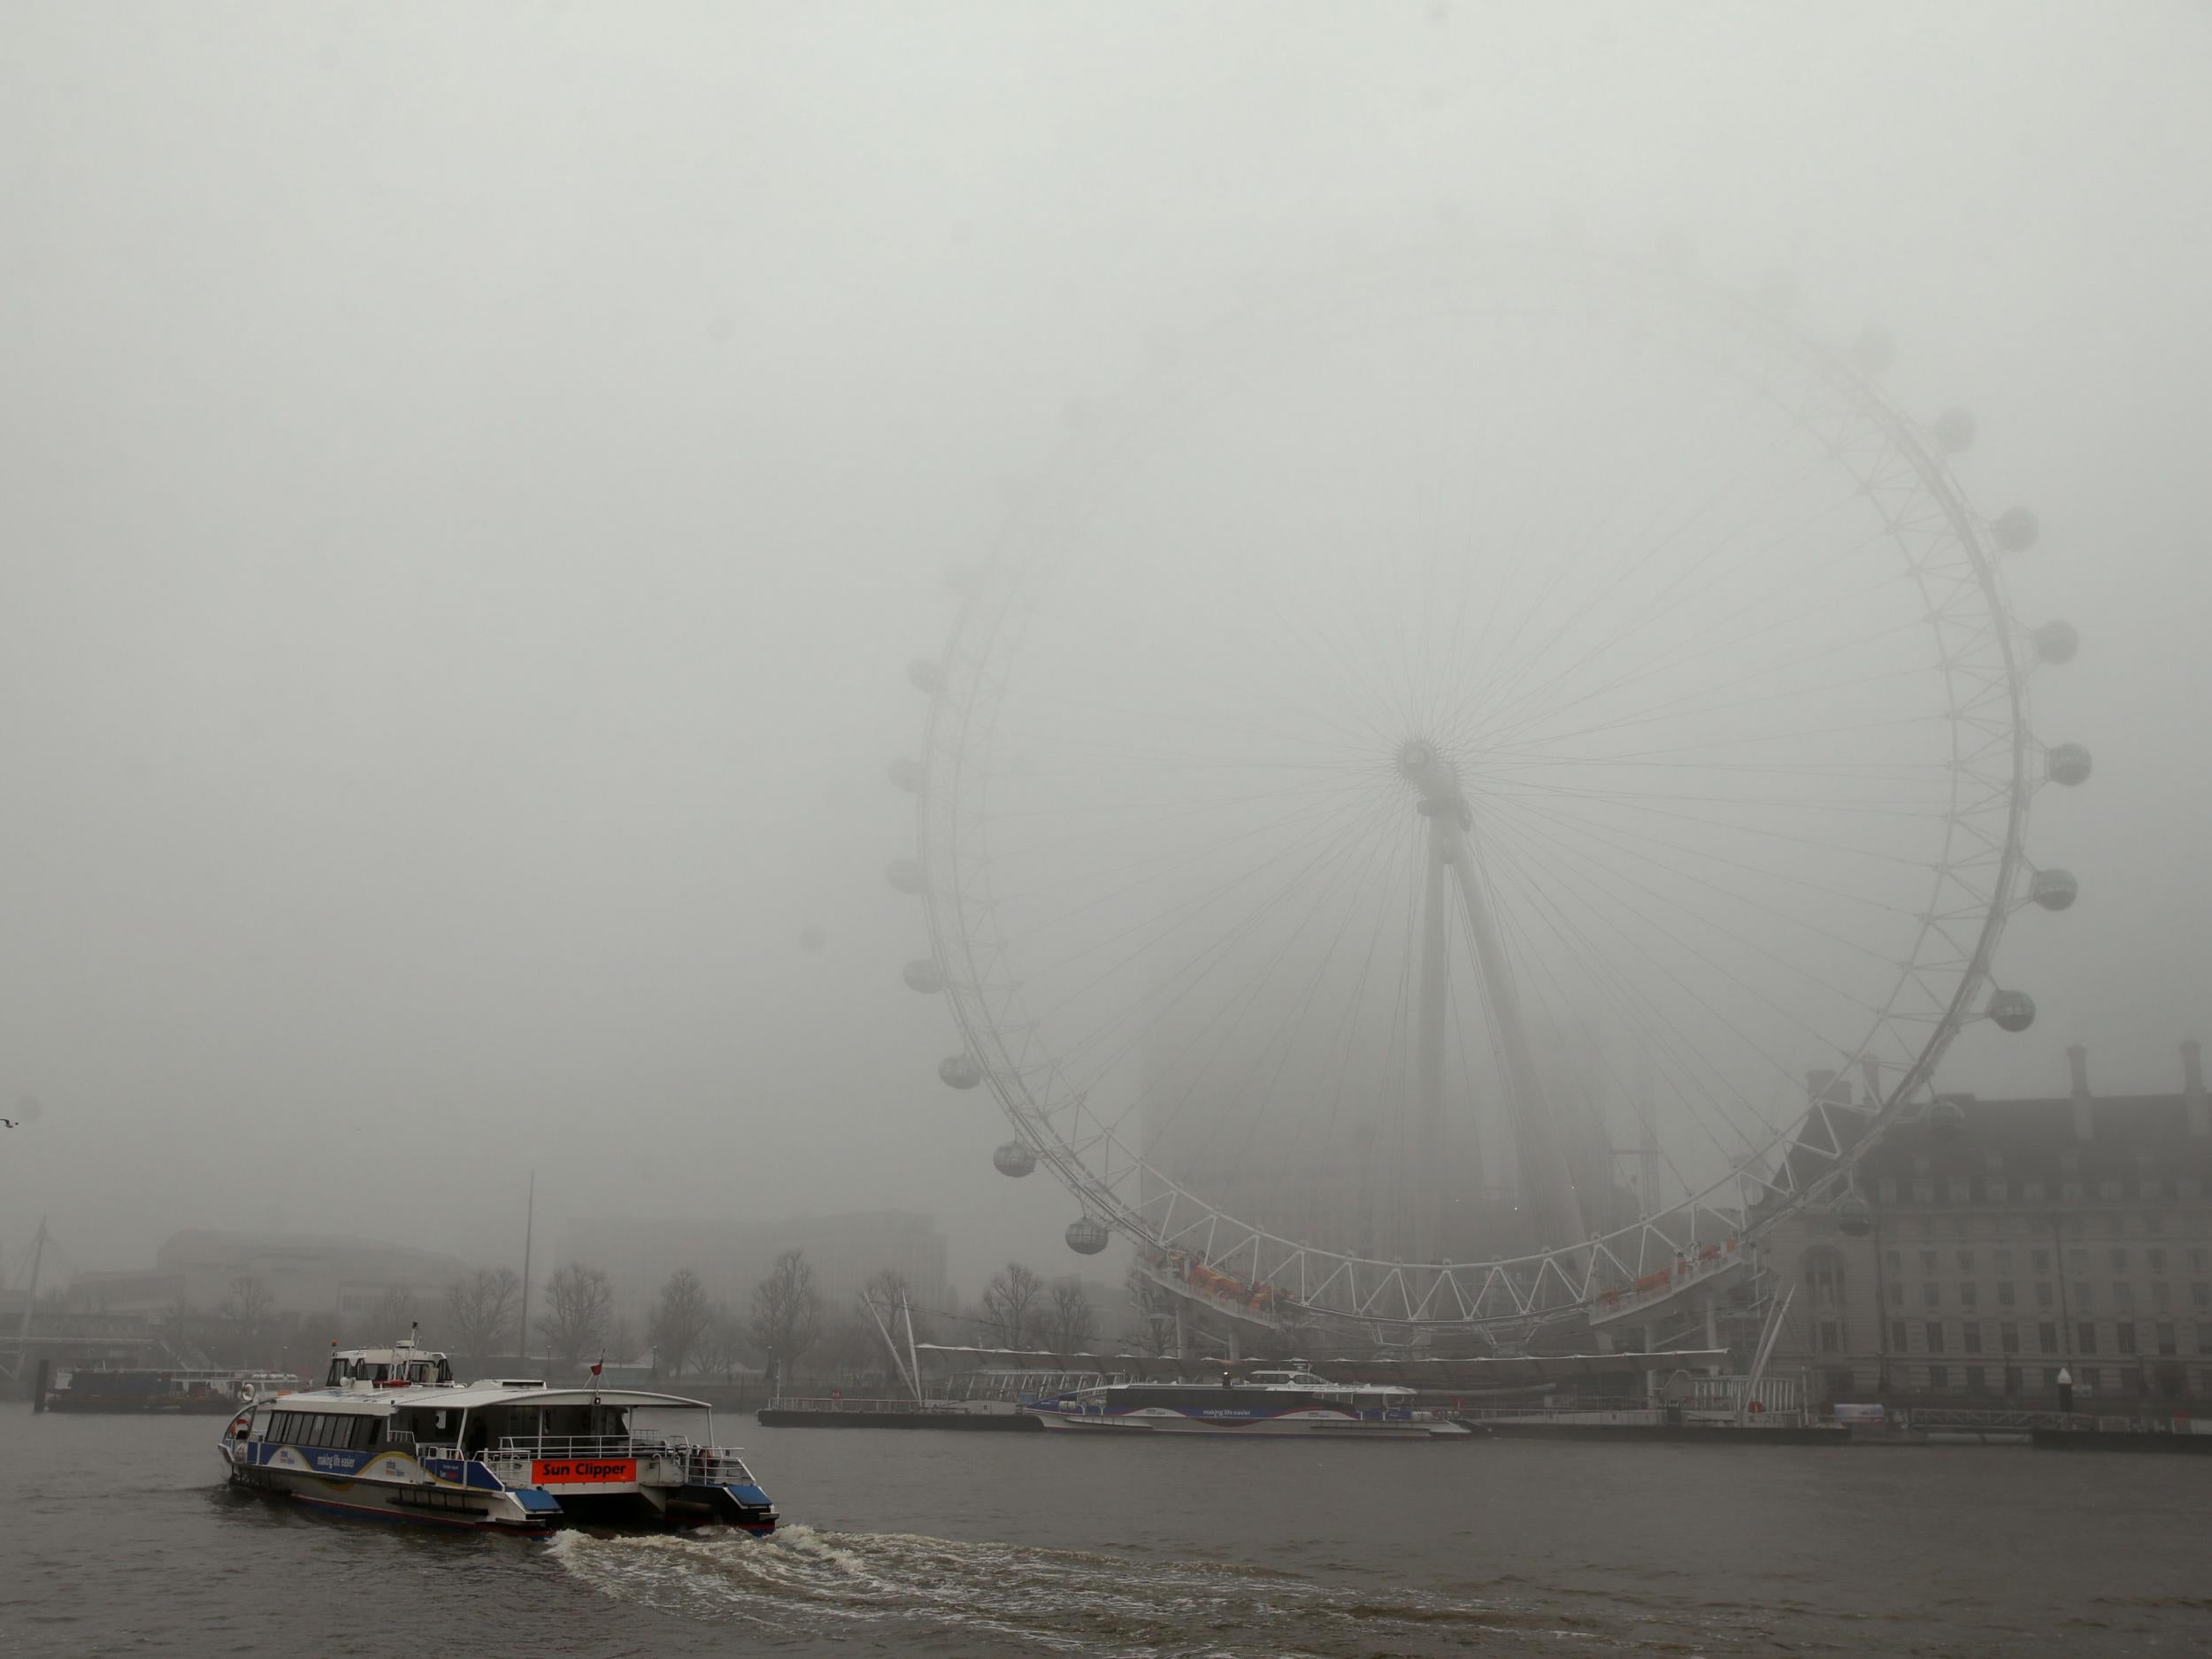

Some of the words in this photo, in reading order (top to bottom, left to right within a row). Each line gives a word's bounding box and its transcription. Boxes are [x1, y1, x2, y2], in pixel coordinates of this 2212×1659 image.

[317, 1454, 333, 1469] making
[341, 1455, 355, 1468] easier
[542, 1463, 571, 1476] Sun
[575, 1463, 626, 1479] Clipper
